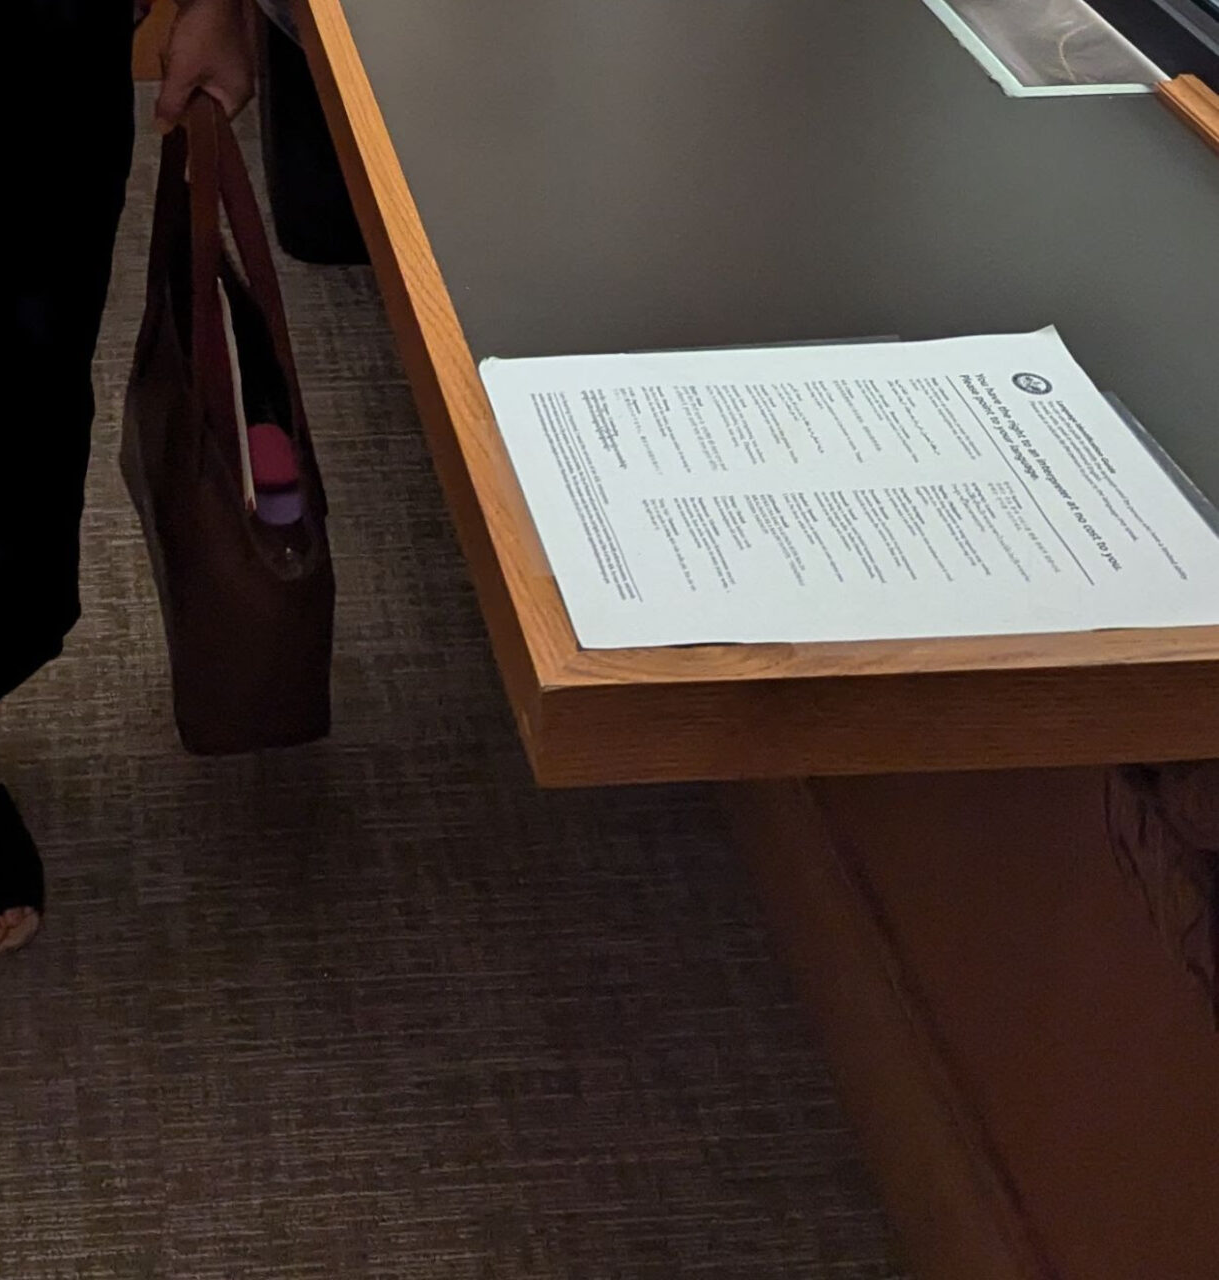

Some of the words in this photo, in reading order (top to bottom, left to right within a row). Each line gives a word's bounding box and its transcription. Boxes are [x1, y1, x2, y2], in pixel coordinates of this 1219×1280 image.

[959, 374, 980, 395] Please
[975, 373, 989, 386] You
[985, 387, 1002, 405] have
[973, 396, 995, 415] point
[998, 407, 1012, 418] the
[989, 416, 1000, 424] to
[993, 426, 1014, 443] your
[1008, 420, 1026, 438] right
[1056, 400, 1077, 423] Language
[1075, 423, 1103, 457] Identification
[1101, 457, 1116, 473] Guide
[1021, 439, 1032, 448] to
[1028, 449, 1040, 457] an
[1009, 445, 1039, 480] language.
[1036, 459, 1072, 499] interpreter
[1067, 501, 1080, 510] at
[1074, 512, 1087, 523] no
[1083, 524, 1102, 540] cost
[1097, 541, 1109, 551] to
[1101, 553, 1122, 571] you.
